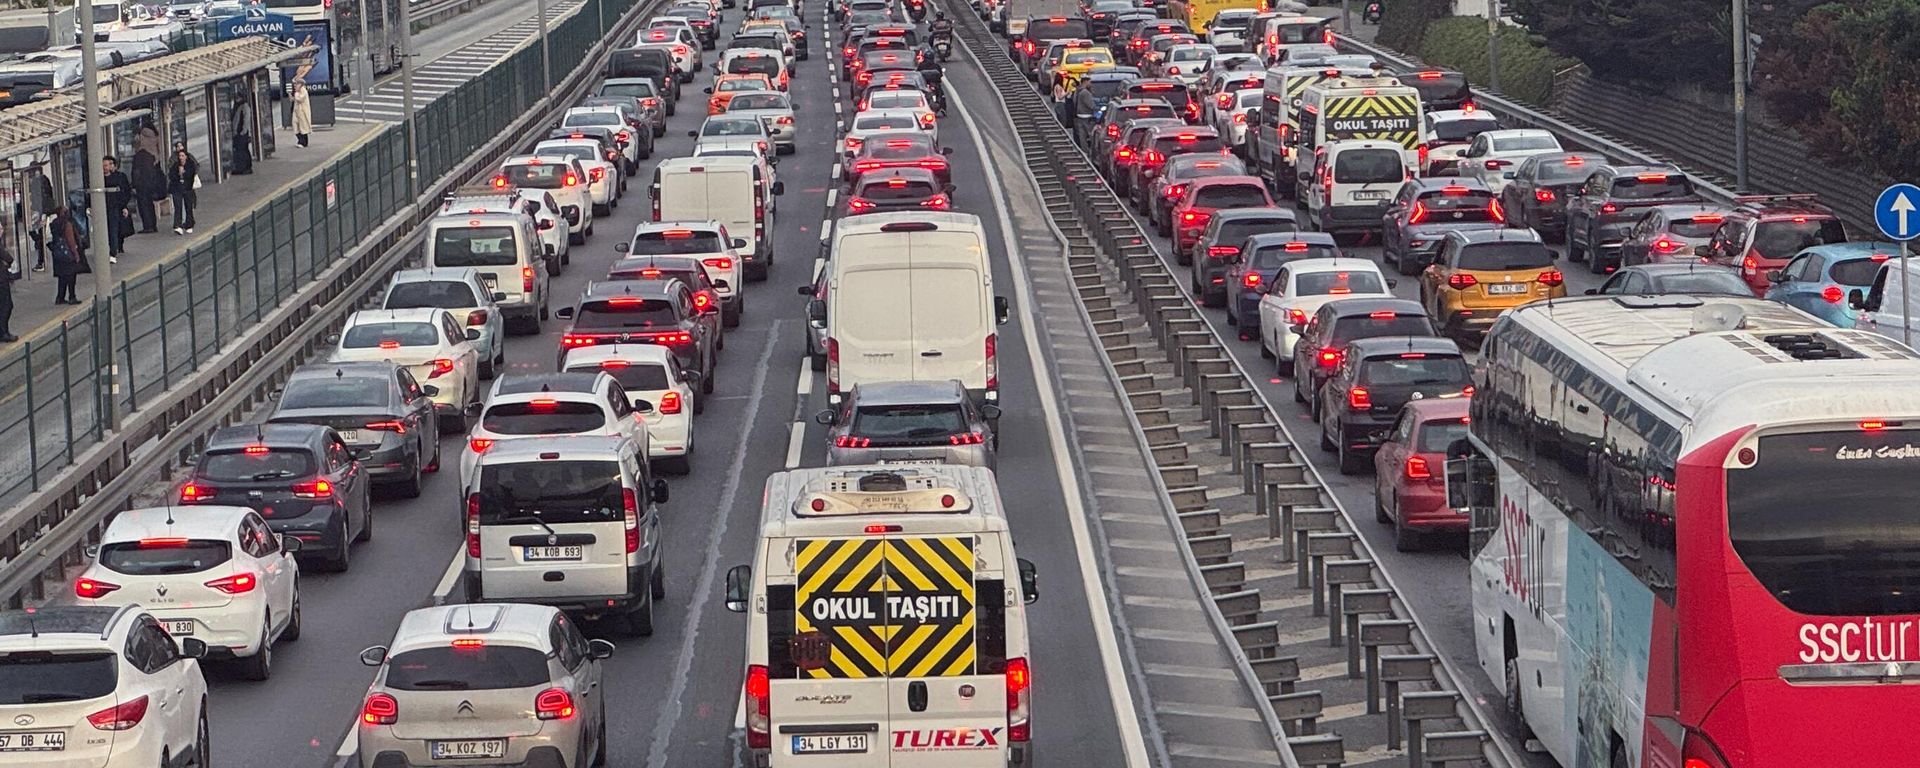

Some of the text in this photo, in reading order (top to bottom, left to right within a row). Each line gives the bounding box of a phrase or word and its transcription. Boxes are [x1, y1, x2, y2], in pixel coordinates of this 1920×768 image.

[231, 23, 283, 36] ÇAĞLAYAN
[1334, 118, 1410, 131] OKUL TAŞITI
[529, 547, 580, 557] 34 KOB 693
[812, 595, 959, 624] OKUL TAŞITI
[176, 622, 192, 632] 830
[1799, 616, 1912, 663] ssctur
[0, 735, 11, 747] 57
[44, 734, 63, 746] 444
[801, 736, 864, 750] 34 LGY 131
[892, 727, 1004, 747] TUREX
[439, 741, 500, 754] 34 KOZ 197
